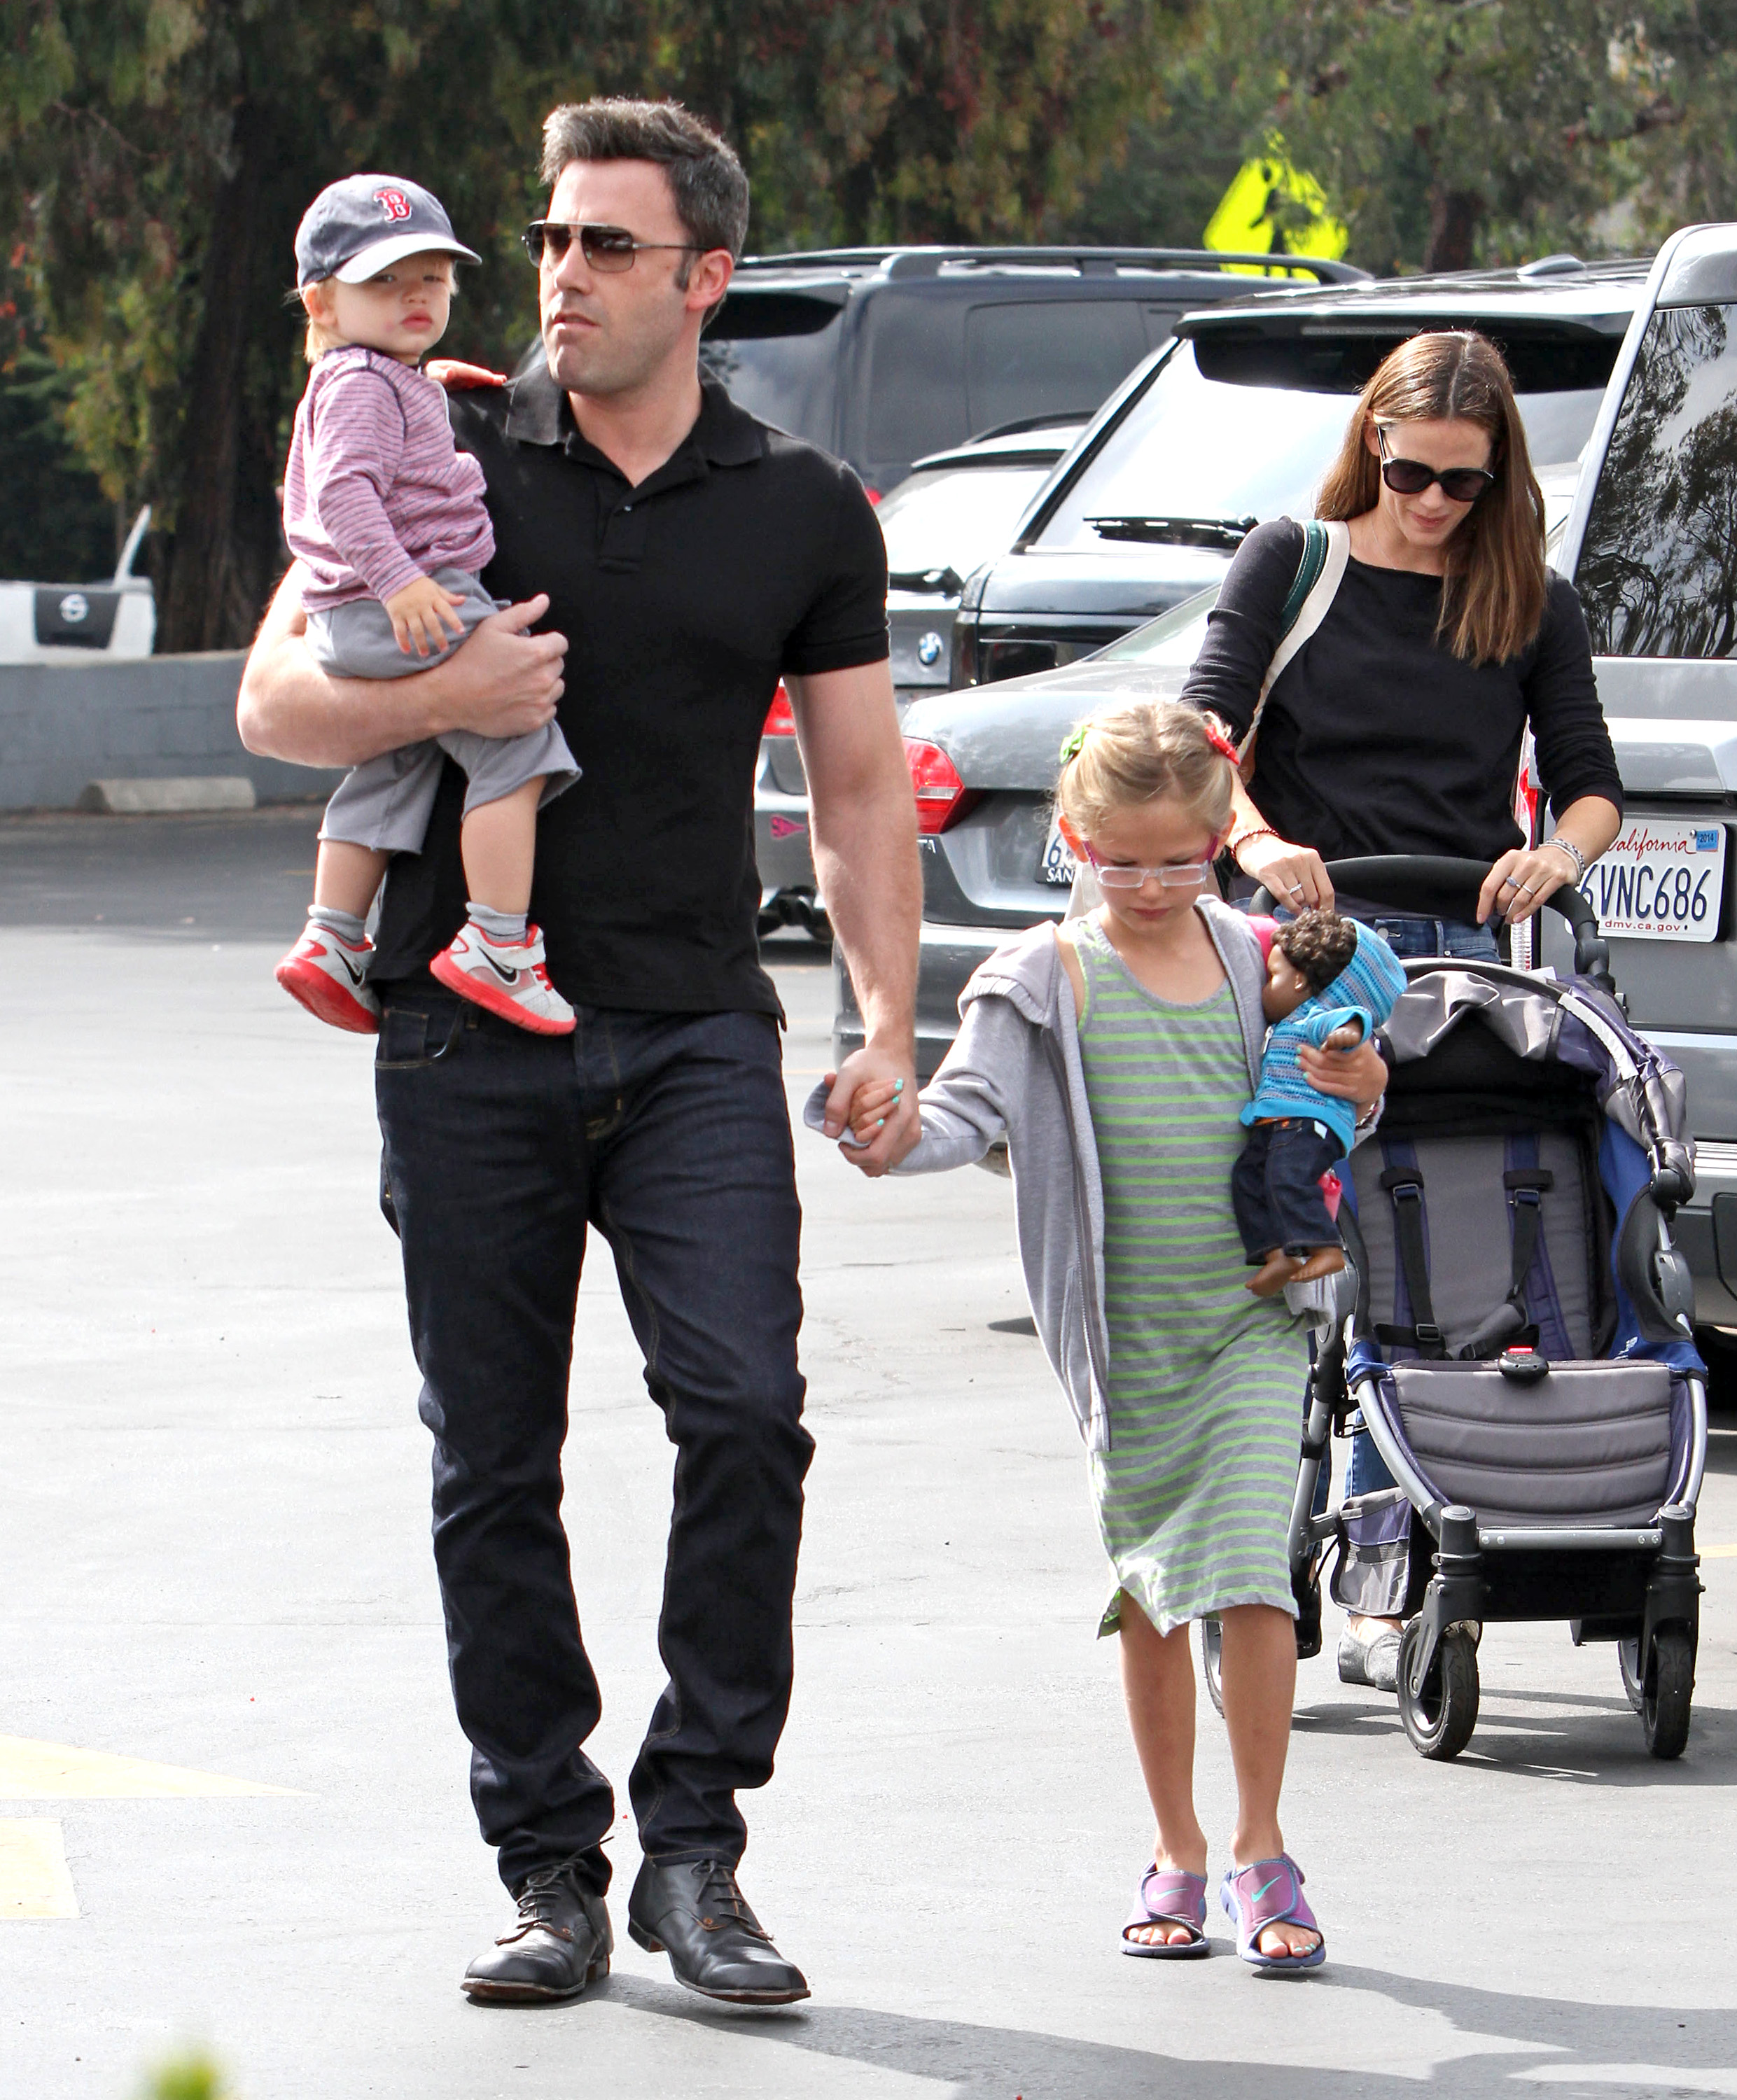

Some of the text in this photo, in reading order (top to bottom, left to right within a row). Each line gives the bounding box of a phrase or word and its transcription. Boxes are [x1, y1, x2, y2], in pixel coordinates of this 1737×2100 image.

[373, 187, 412, 224] B
[1699, 833, 1714, 843] 2014
[1580, 864, 1711, 921] 6VNC686
[1605, 919, 1681, 932] dmv.ca.gov
